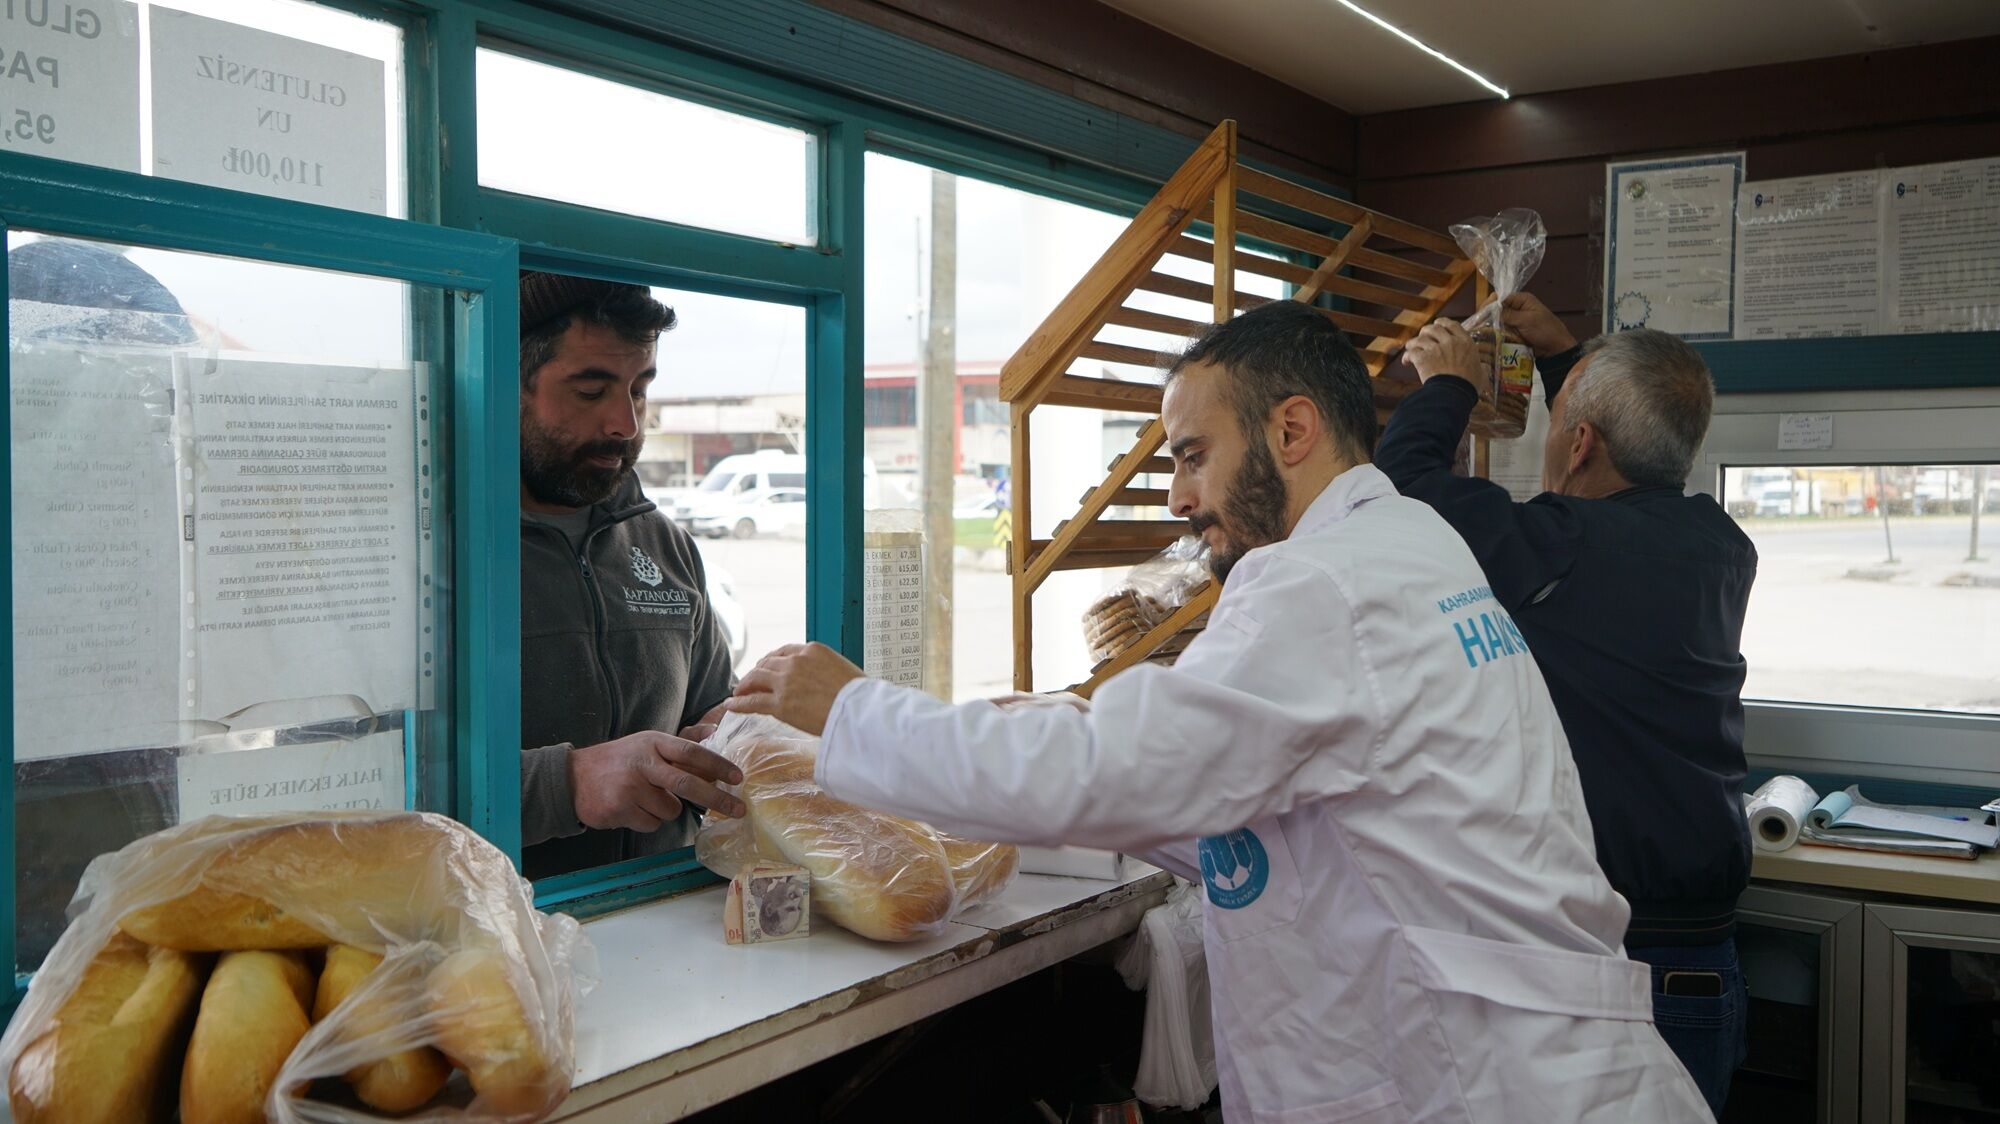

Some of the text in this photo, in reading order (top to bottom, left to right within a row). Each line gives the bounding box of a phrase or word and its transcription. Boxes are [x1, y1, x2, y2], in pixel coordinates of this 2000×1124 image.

[872, 551, 891, 560] EKMEK
[872, 565, 892, 573] EKMEK
[622, 586, 689, 603] KAPTANOĞLU
[873, 592, 892, 601] EKMEK
